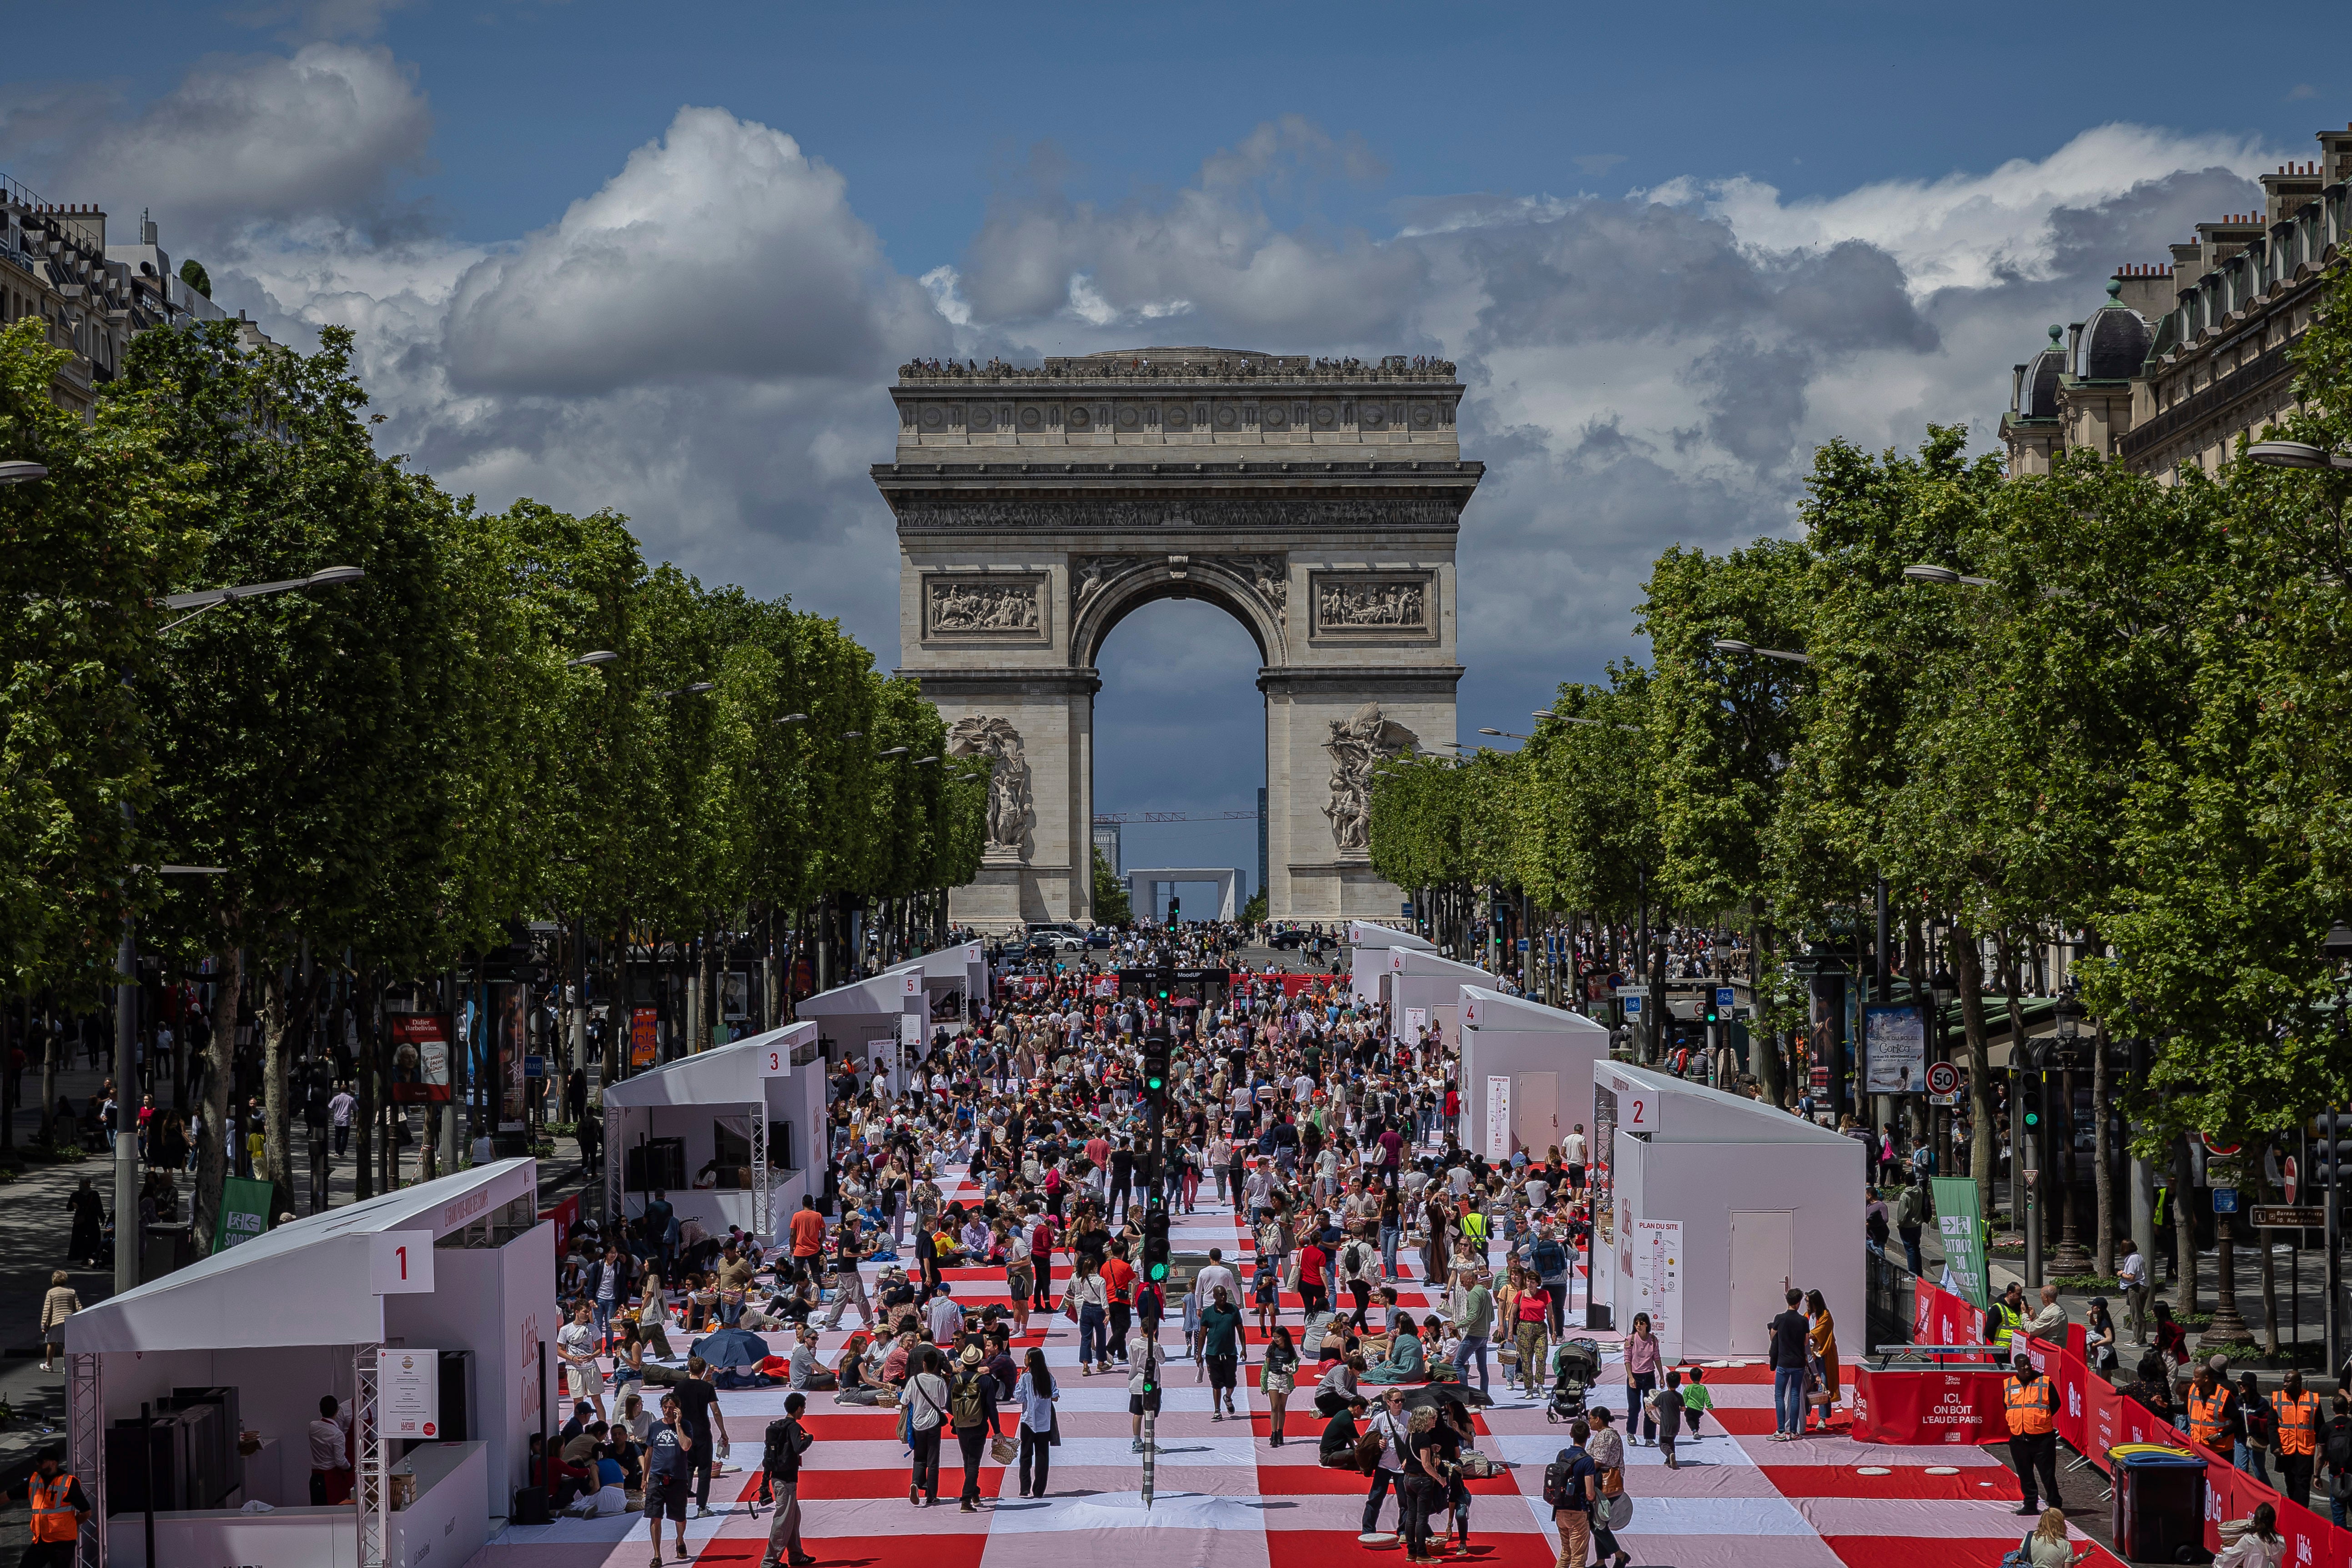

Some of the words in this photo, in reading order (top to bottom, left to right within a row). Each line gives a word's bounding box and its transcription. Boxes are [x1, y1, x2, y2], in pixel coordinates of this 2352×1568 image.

[1354, 931, 1359, 940] 8
[970, 950, 975, 959] 7
[1394, 957, 1400, 968] 6
[907, 979, 913, 991] 5
[1467, 1005, 1474, 1020] 4
[525, 1062, 542, 1070] TAXIS
[770, 1052, 779, 1070] 3
[1933, 1072, 1953, 1086] 50
[1633, 1100, 1644, 1123] 2
[1622, 1197, 1632, 1238] Life's
[395, 1246, 407, 1281] 1
[1621, 1237, 1633, 1279] Good.
[521, 1312, 538, 1369] Life's
[1947, 1321, 1953, 1344] LG
[2030, 1350, 2045, 1369] GRAND
[1944, 1393, 1961, 1405] ICI,
[2075, 1391, 2081, 1418] LG
[1933, 1405, 1949, 1414] ON
[1950, 1405, 1973, 1414] BOIT
[1922, 1416, 1945, 1424] L'EAU
[1959, 1416, 1983, 1424] PARIS
[2212, 1490, 2221, 1523] LG
[2297, 1533, 2312, 1566] Life's
